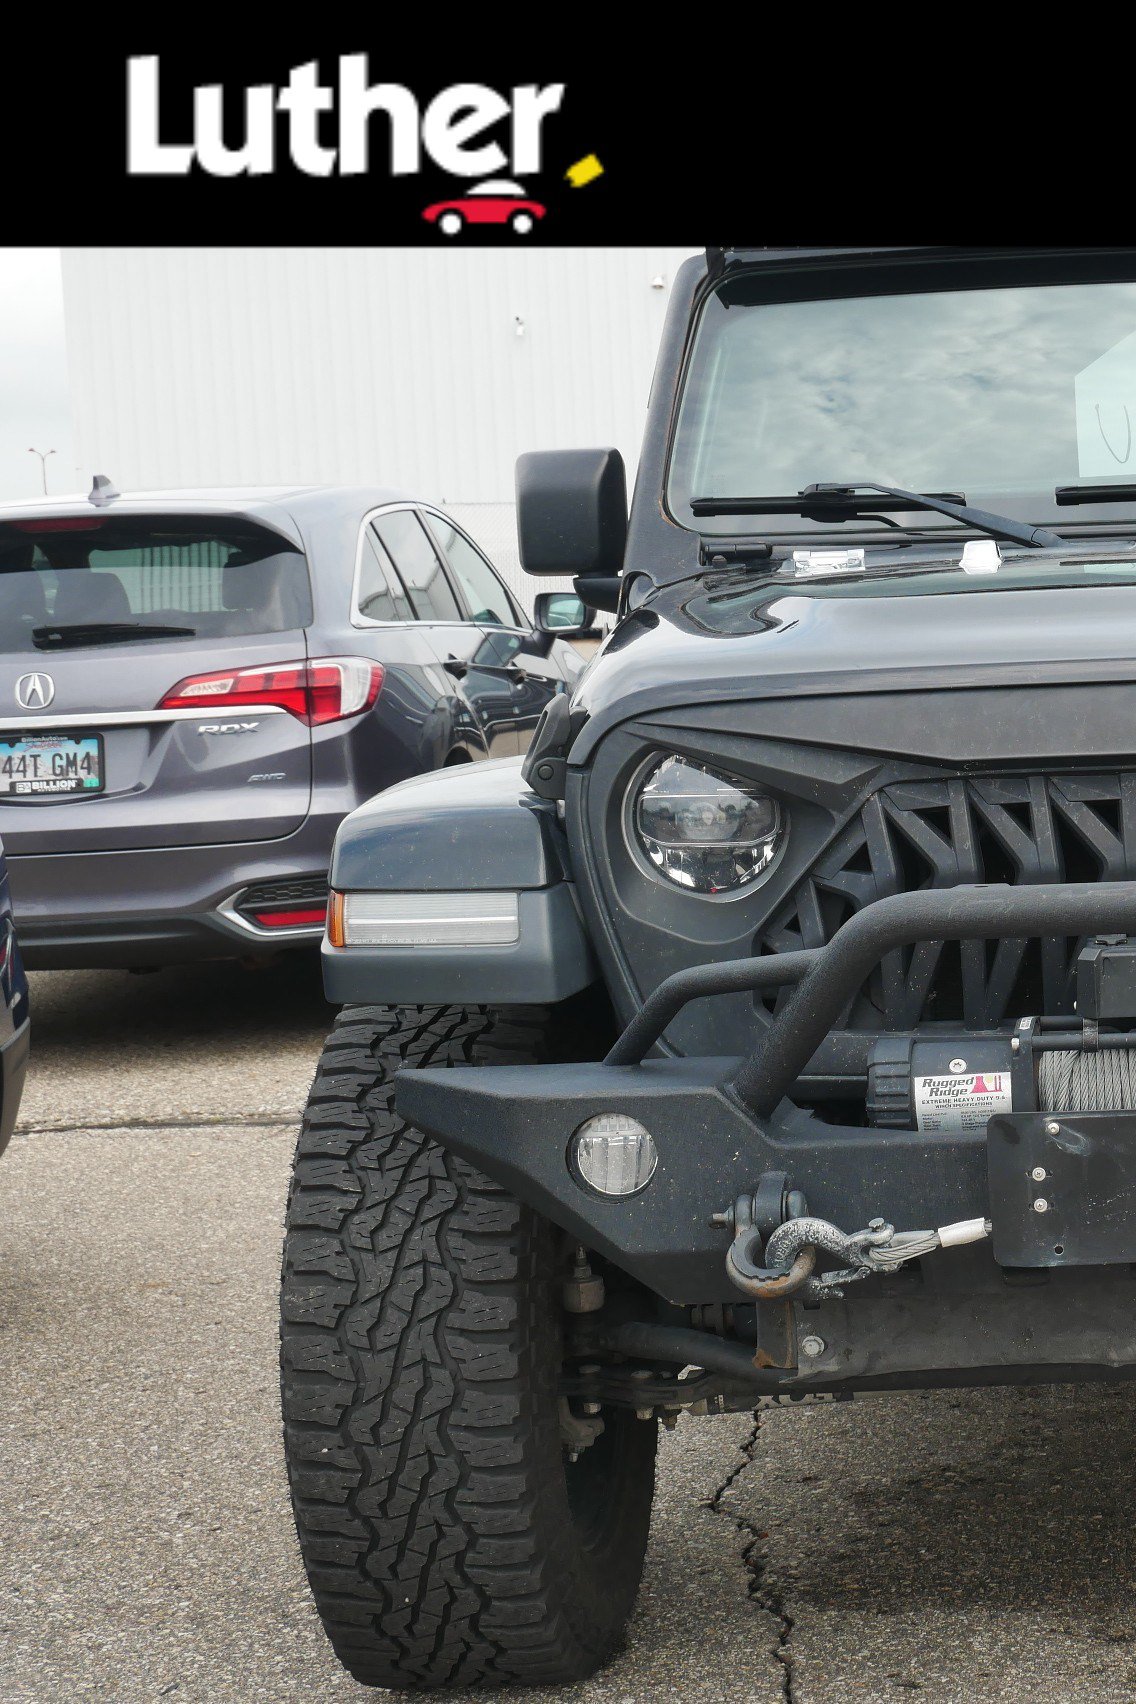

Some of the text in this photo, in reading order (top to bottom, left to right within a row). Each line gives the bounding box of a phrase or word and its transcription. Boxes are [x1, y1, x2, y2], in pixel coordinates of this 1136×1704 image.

[198, 722, 260, 736] RDX
[2, 752, 91, 778] 44T GM4
[247, 772, 287, 783] AWD
[32, 780, 76, 789] BILLION
[922, 1077, 974, 1088] Rugged
[929, 1087, 968, 1097] Ridge
